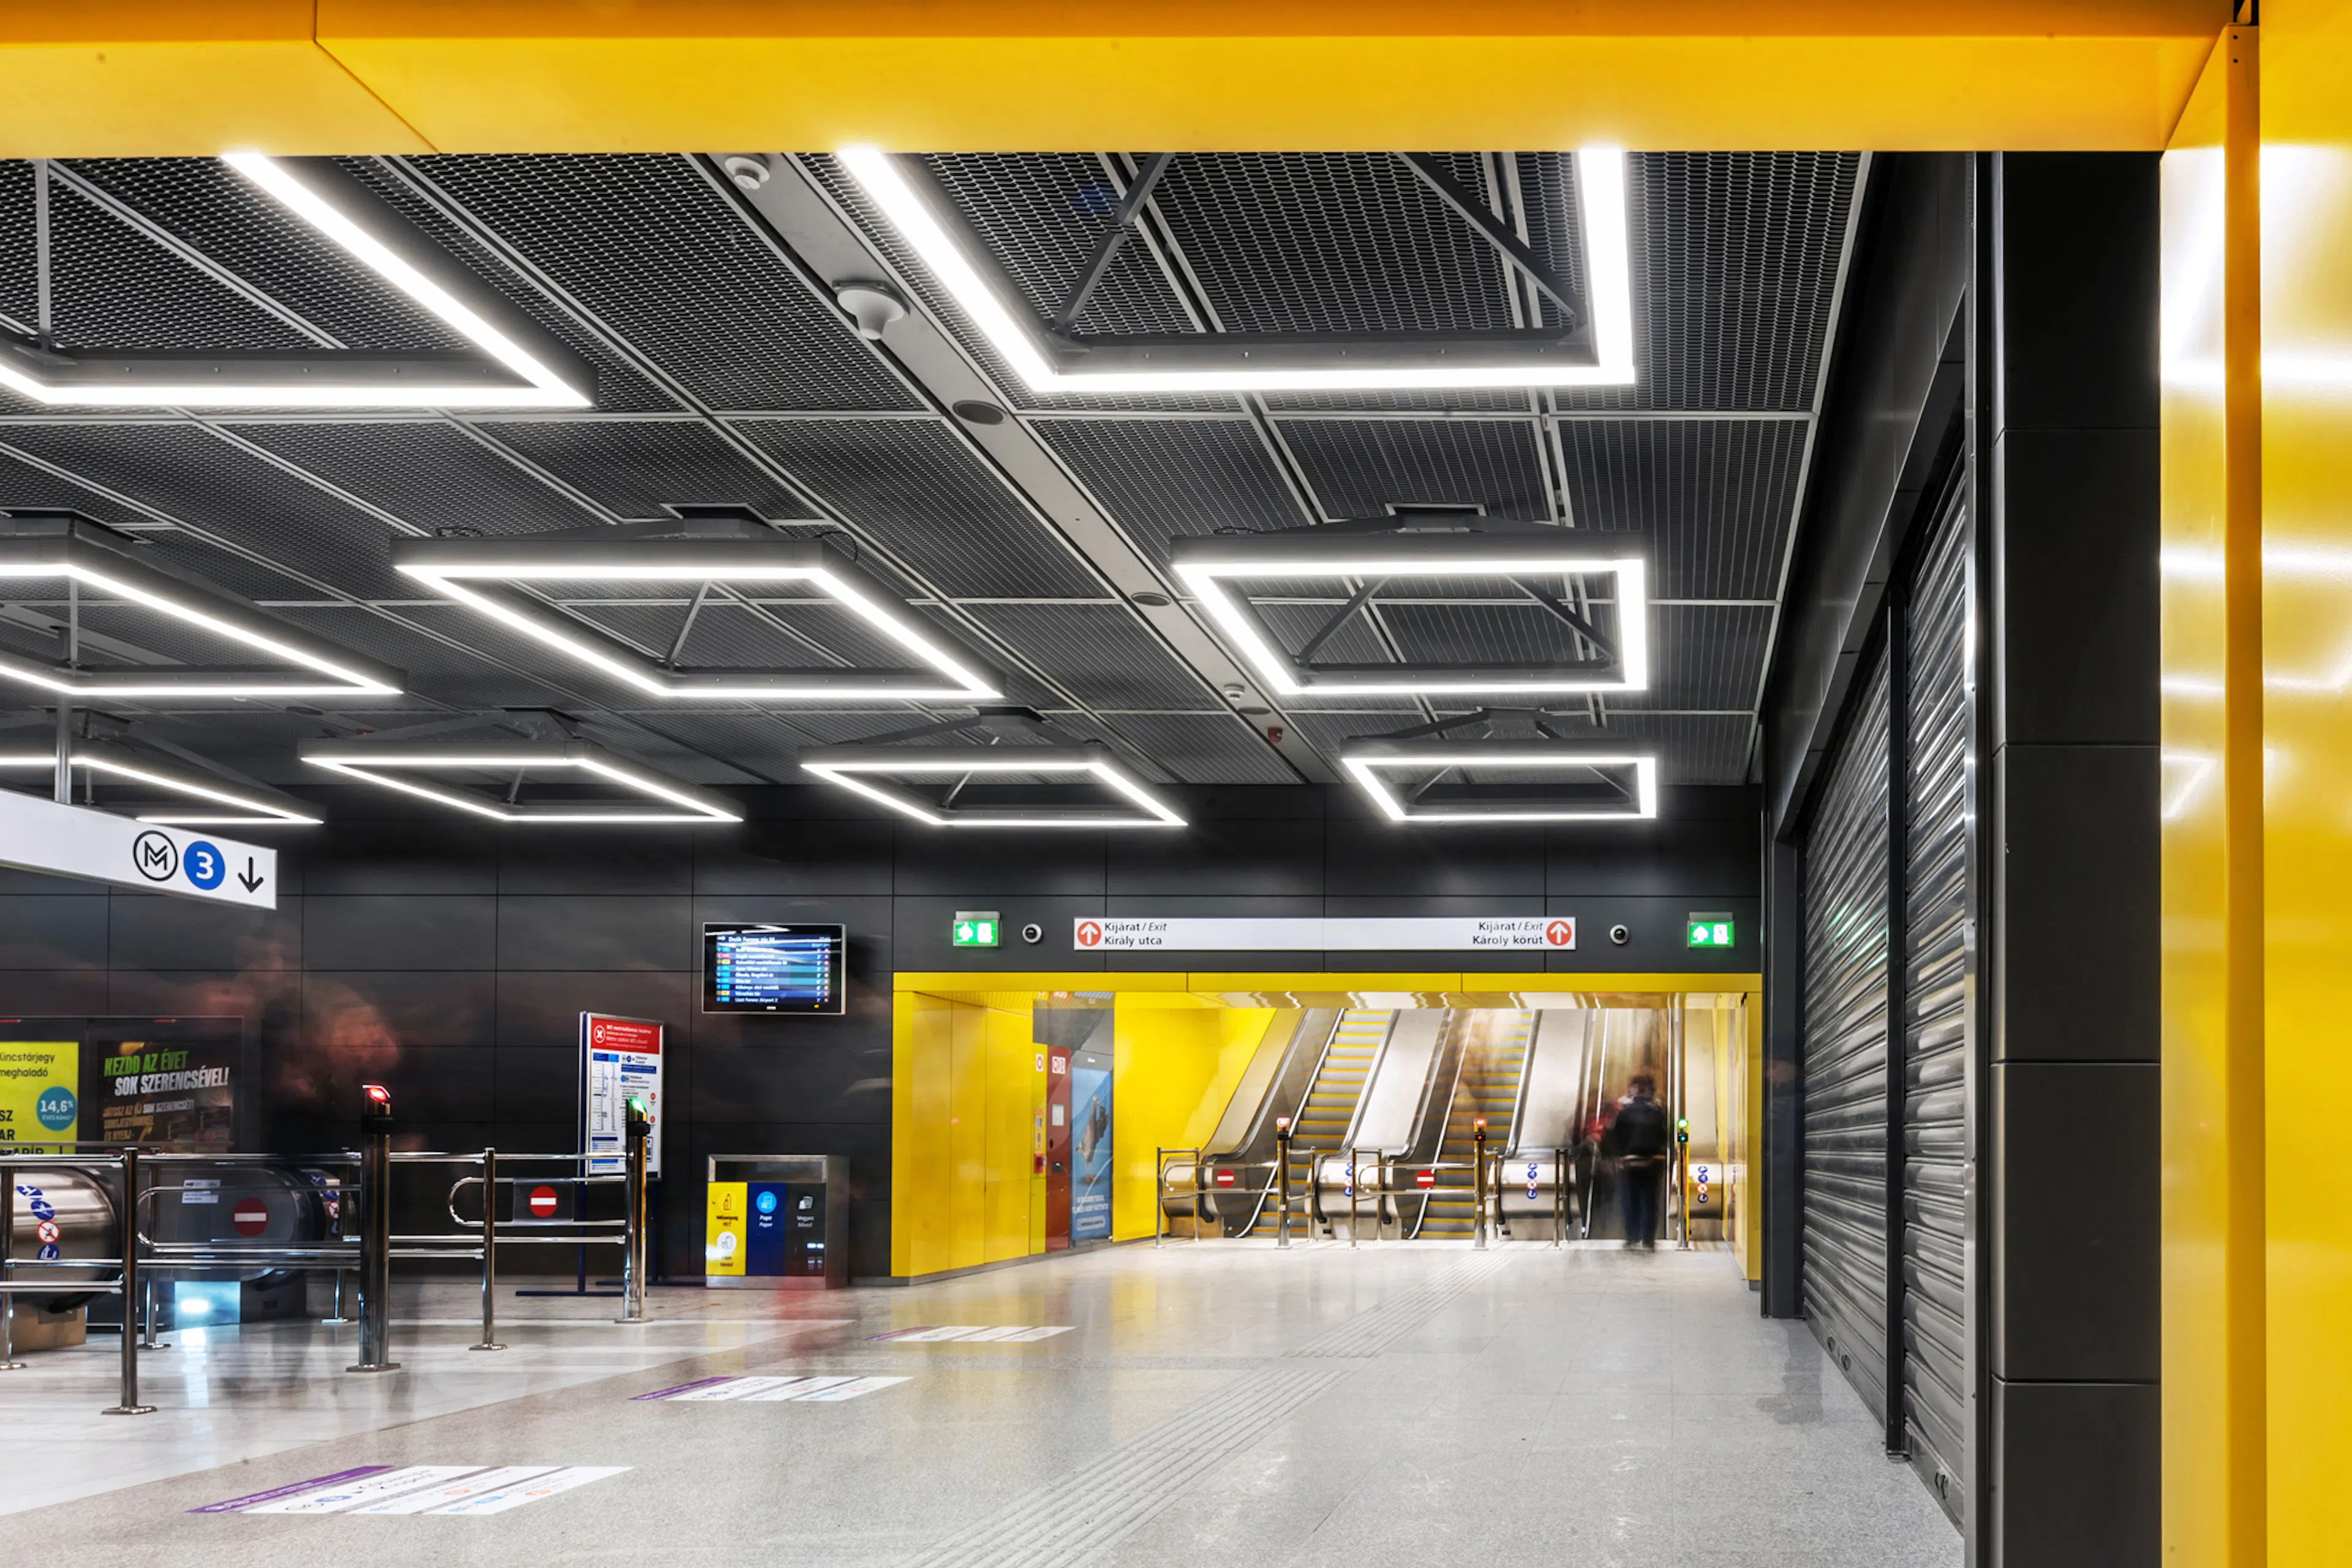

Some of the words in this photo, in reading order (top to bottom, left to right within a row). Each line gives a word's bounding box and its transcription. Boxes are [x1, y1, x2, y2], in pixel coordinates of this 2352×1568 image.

[195, 850, 214, 880] 3
[1104, 922, 1140, 933] Kijárat
[1148, 922, 1167, 932] Exit
[1479, 922, 1515, 933] Kijárat
[1525, 922, 1543, 931] Exit
[1104, 936, 1134, 948] Király
[1472, 935, 1509, 947] Károly
[1513, 935, 1543, 945] körút
[143, 1053, 159, 1072] AZ
[160, 1048, 189, 1071] ÉVET
[115, 1076, 139, 1096] SOK
[140, 1065, 230, 1094] SZERENCSÉVEL!
